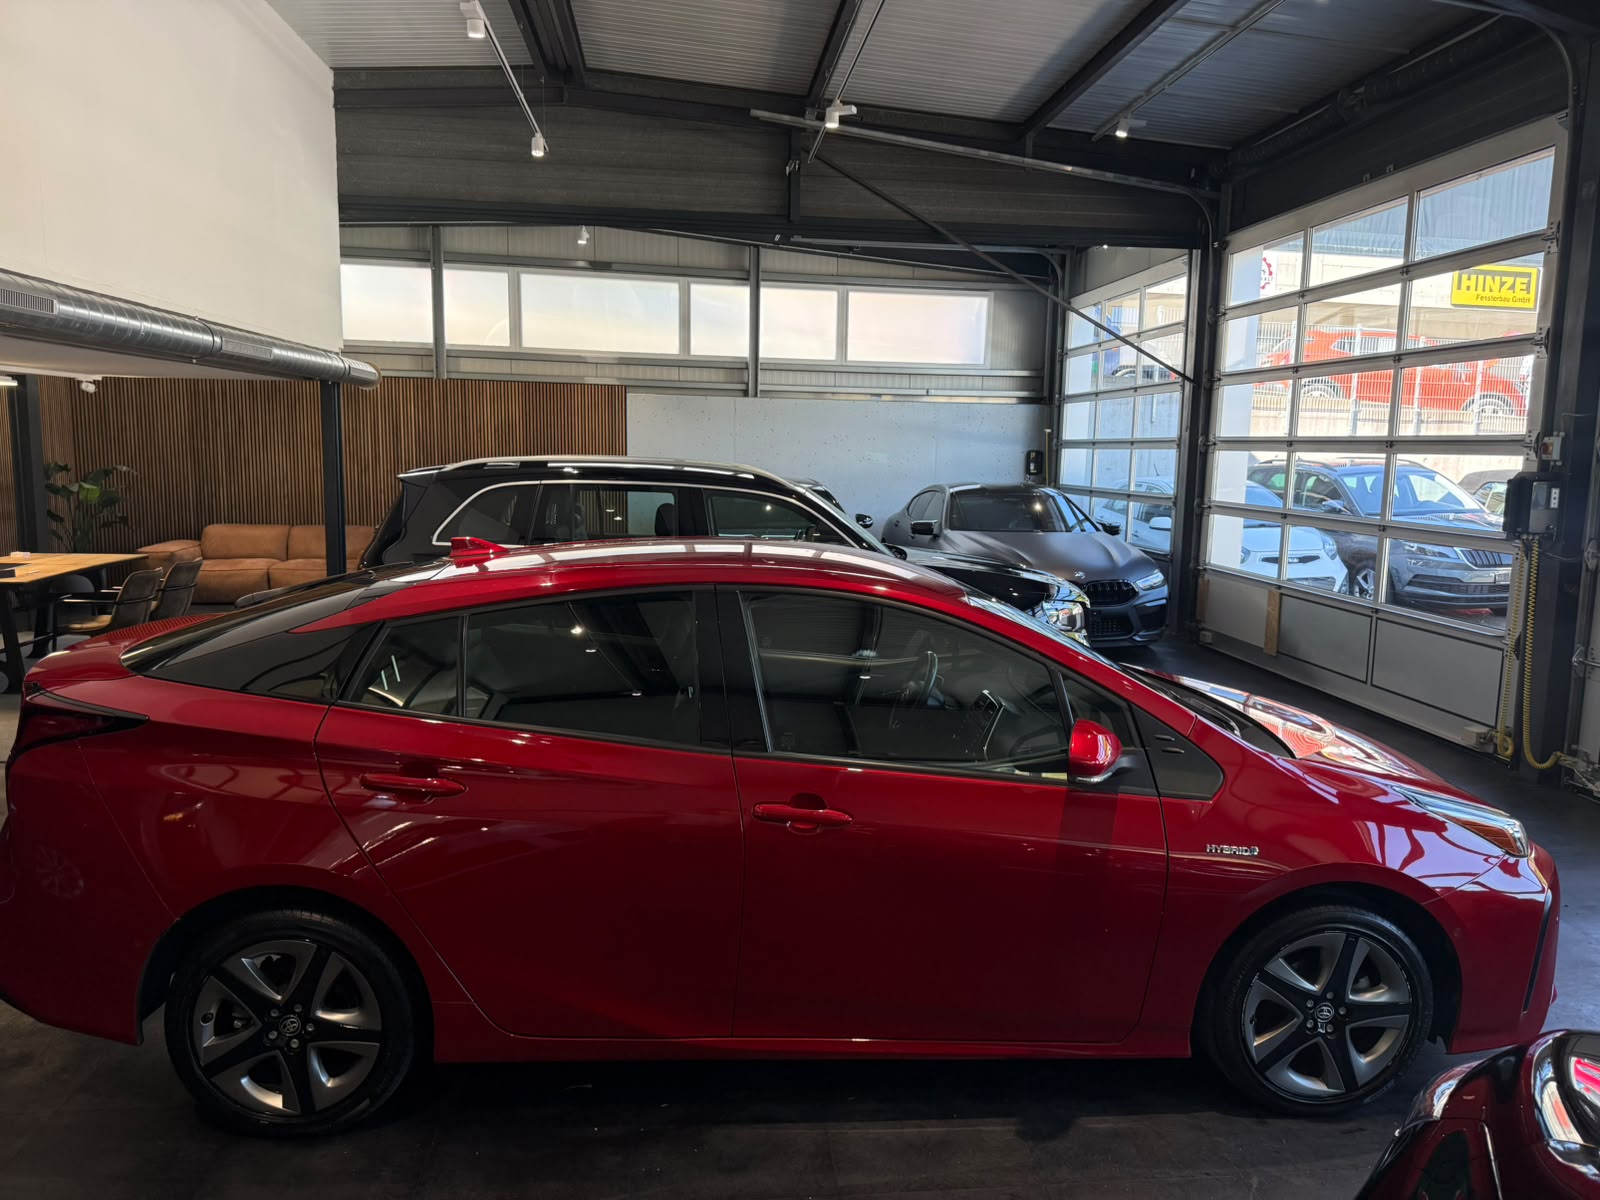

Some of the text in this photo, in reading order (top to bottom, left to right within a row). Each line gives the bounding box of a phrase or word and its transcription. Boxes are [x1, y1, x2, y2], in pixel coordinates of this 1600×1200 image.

[1461, 274, 1530, 294] HINZE
[1475, 294, 1510, 303] Fensterbau
[1206, 843, 1250, 856] HYBRID
